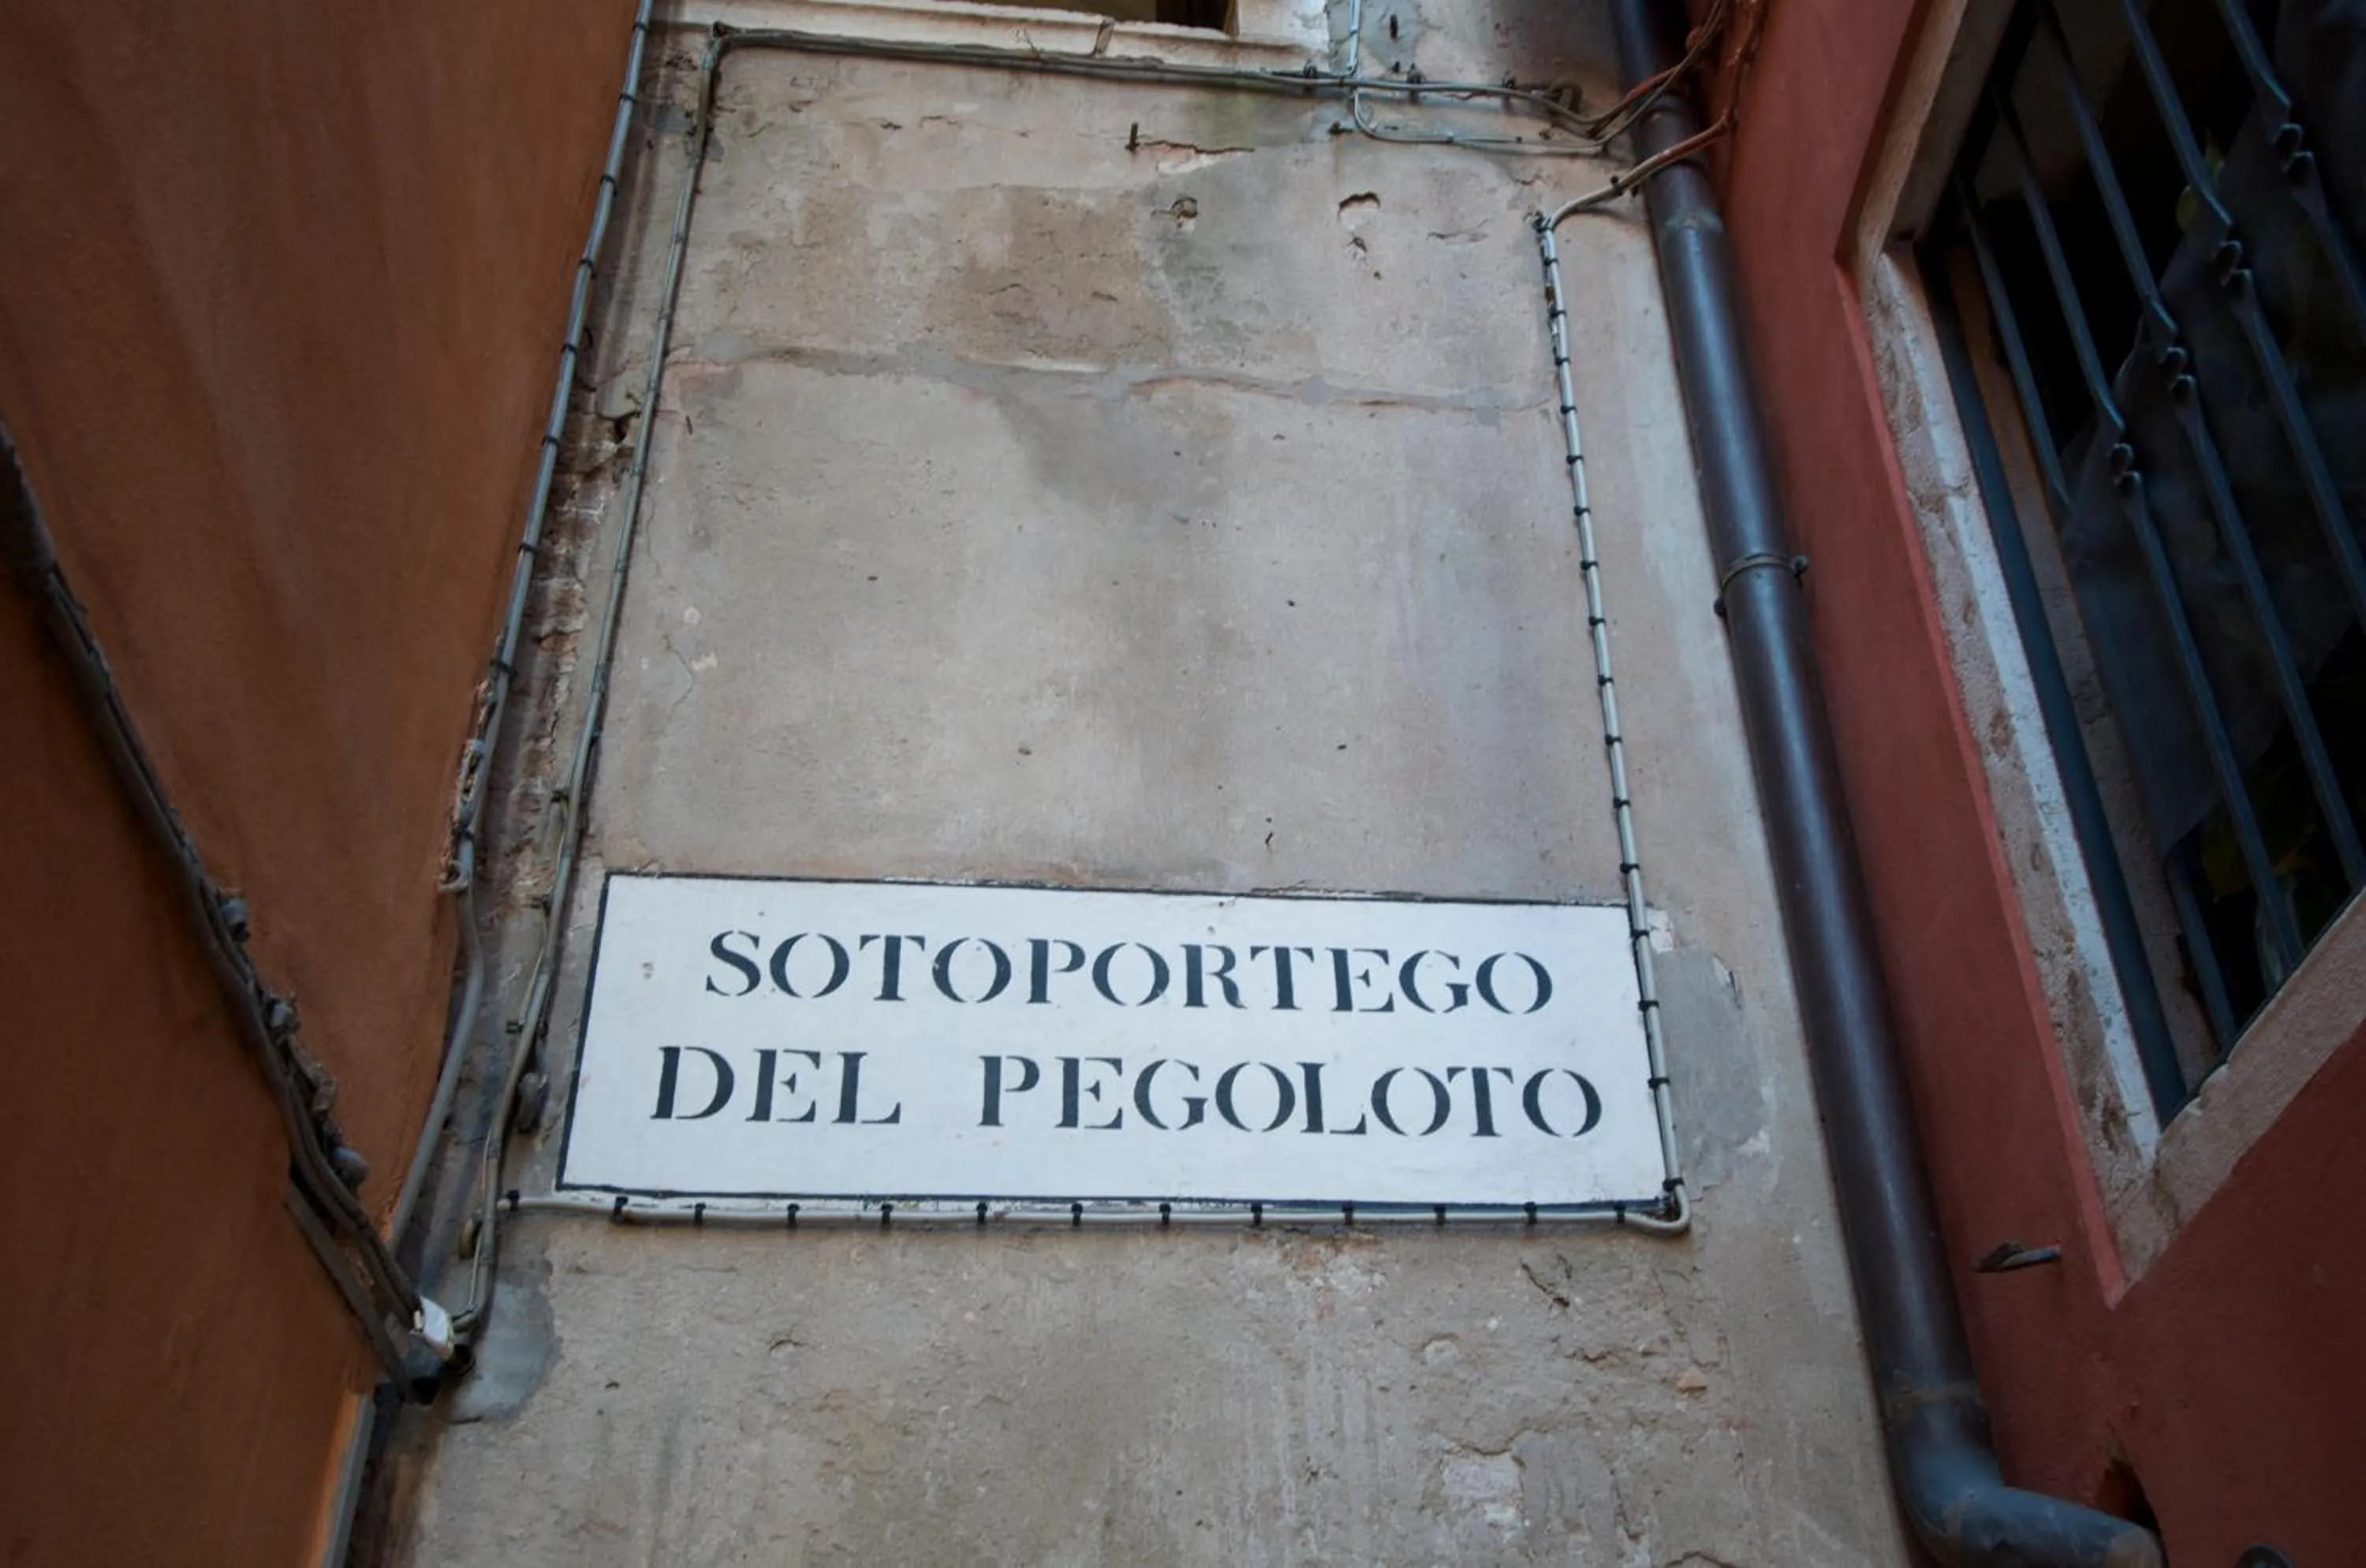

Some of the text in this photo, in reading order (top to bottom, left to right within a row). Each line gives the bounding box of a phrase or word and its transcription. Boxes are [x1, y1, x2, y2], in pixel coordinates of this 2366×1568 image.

[706, 929, 1554, 1015] SOTOPORTEGO
[649, 1045, 1603, 1137] DEL PEGOLOTO
